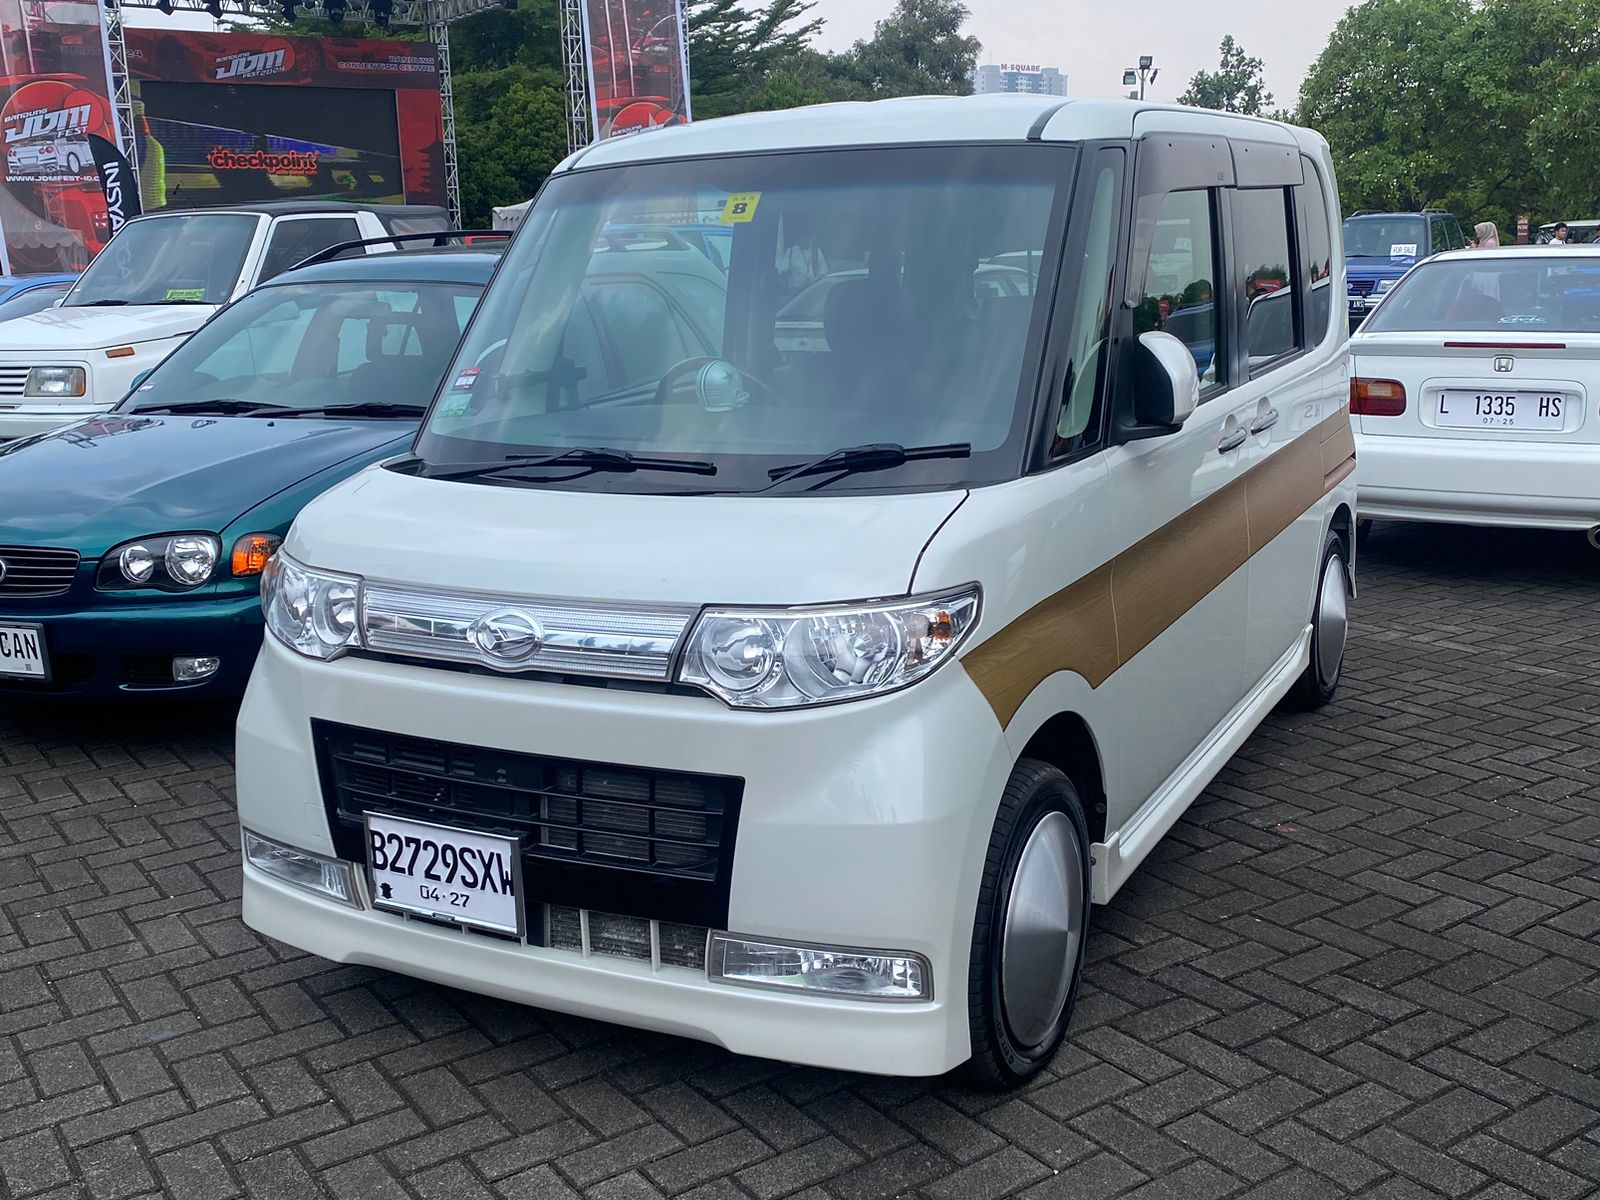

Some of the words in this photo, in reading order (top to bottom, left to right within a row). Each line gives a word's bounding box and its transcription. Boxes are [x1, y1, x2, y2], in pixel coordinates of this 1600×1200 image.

[215, 49, 285, 80] JDM
[388, 55, 435, 65] BANDUNG
[337, 61, 399, 71] CONVENTION
[399, 64, 436, 73] CENTRE
[1000, 63, 1041, 72] M-SQUARE
[4, 108, 48, 123] BANDUNG
[4, 104, 92, 143] JDM
[57, 126, 88, 138] FEST
[211, 150, 318, 173] checkpoint
[731, 202, 748, 215] 8
[1392, 246, 1403, 254] FOR
[1403, 245, 1415, 254] SALE
[1439, 394, 1450, 415] L
[1474, 395, 1517, 416] 1335
[1538, 397, 1562, 418] HS
